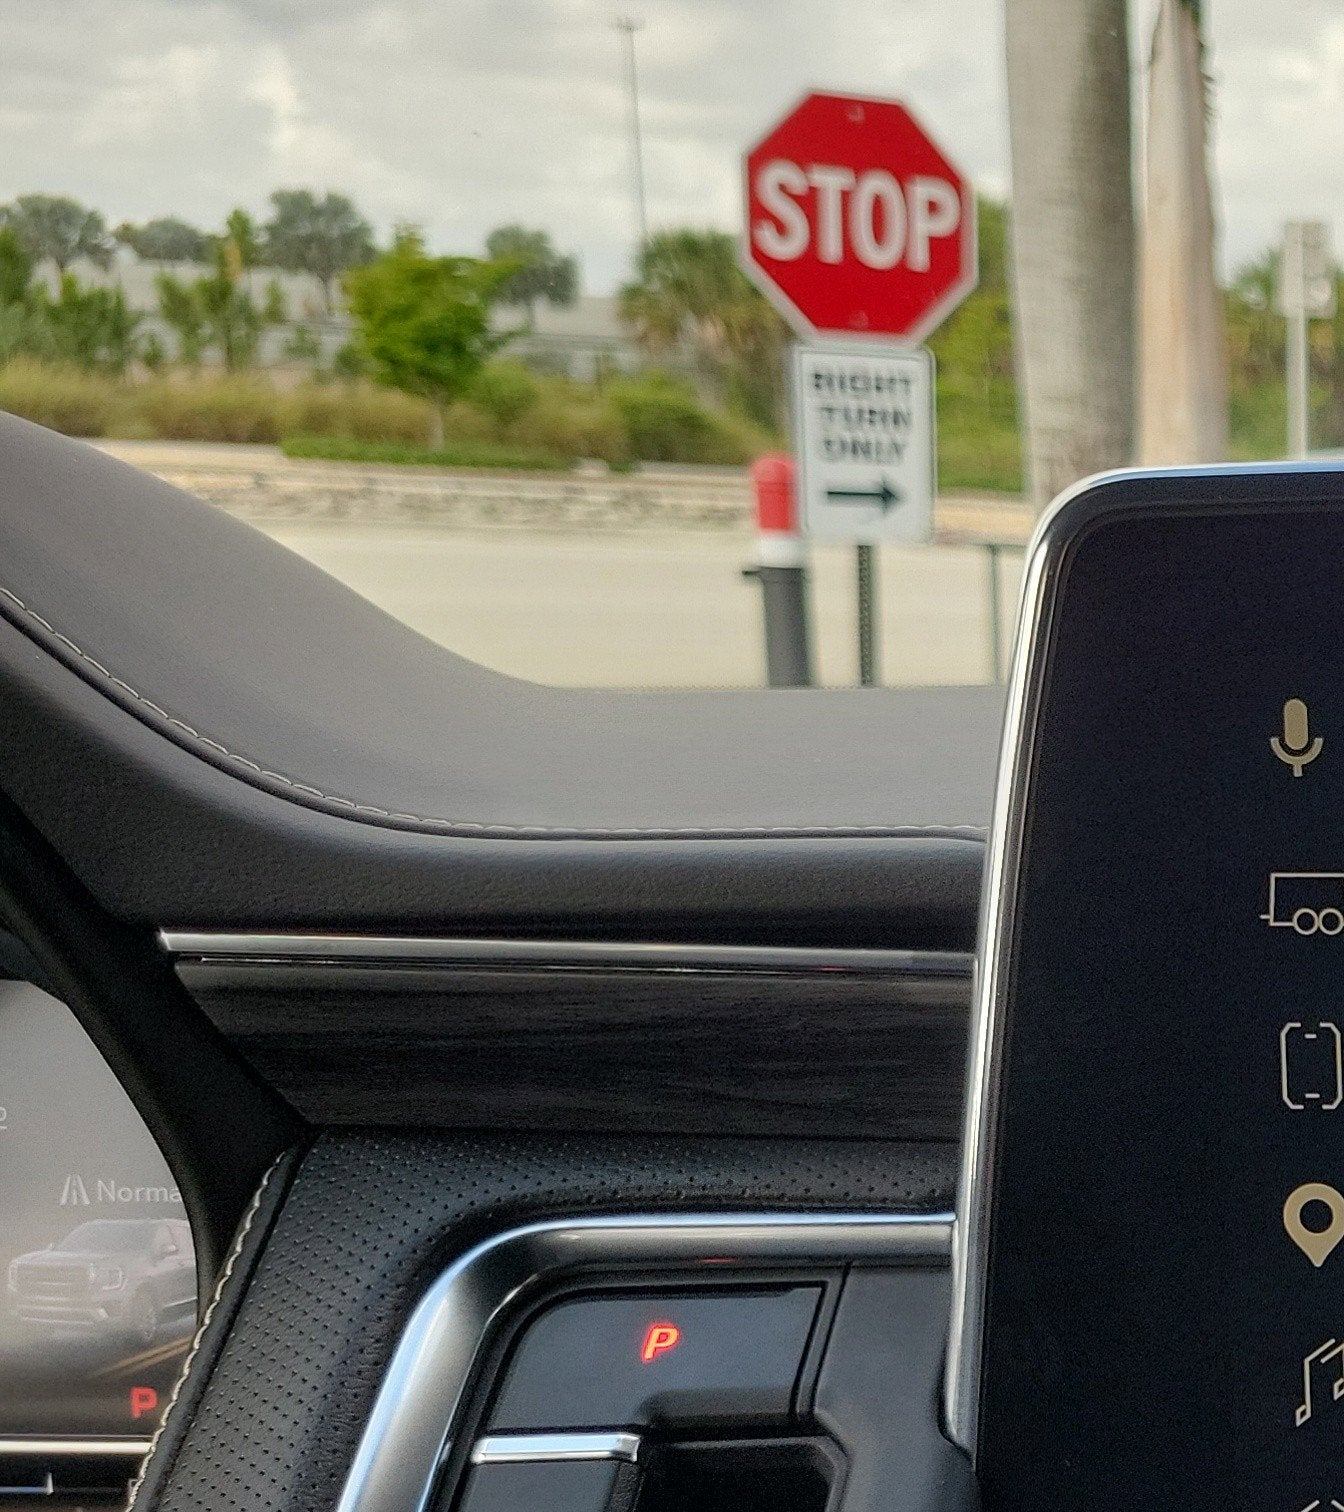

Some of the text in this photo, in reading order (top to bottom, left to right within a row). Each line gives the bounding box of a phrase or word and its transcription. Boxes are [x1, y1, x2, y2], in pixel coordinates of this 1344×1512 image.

[752, 159, 963, 274] STOP
[814, 371, 912, 394] RIGHT
[820, 404, 912, 429] TURN
[822, 437, 905, 463] ONLY
[98, 1180, 183, 1203] Norma
[642, 1322, 680, 1361] P
[130, 1386, 159, 1419] P
